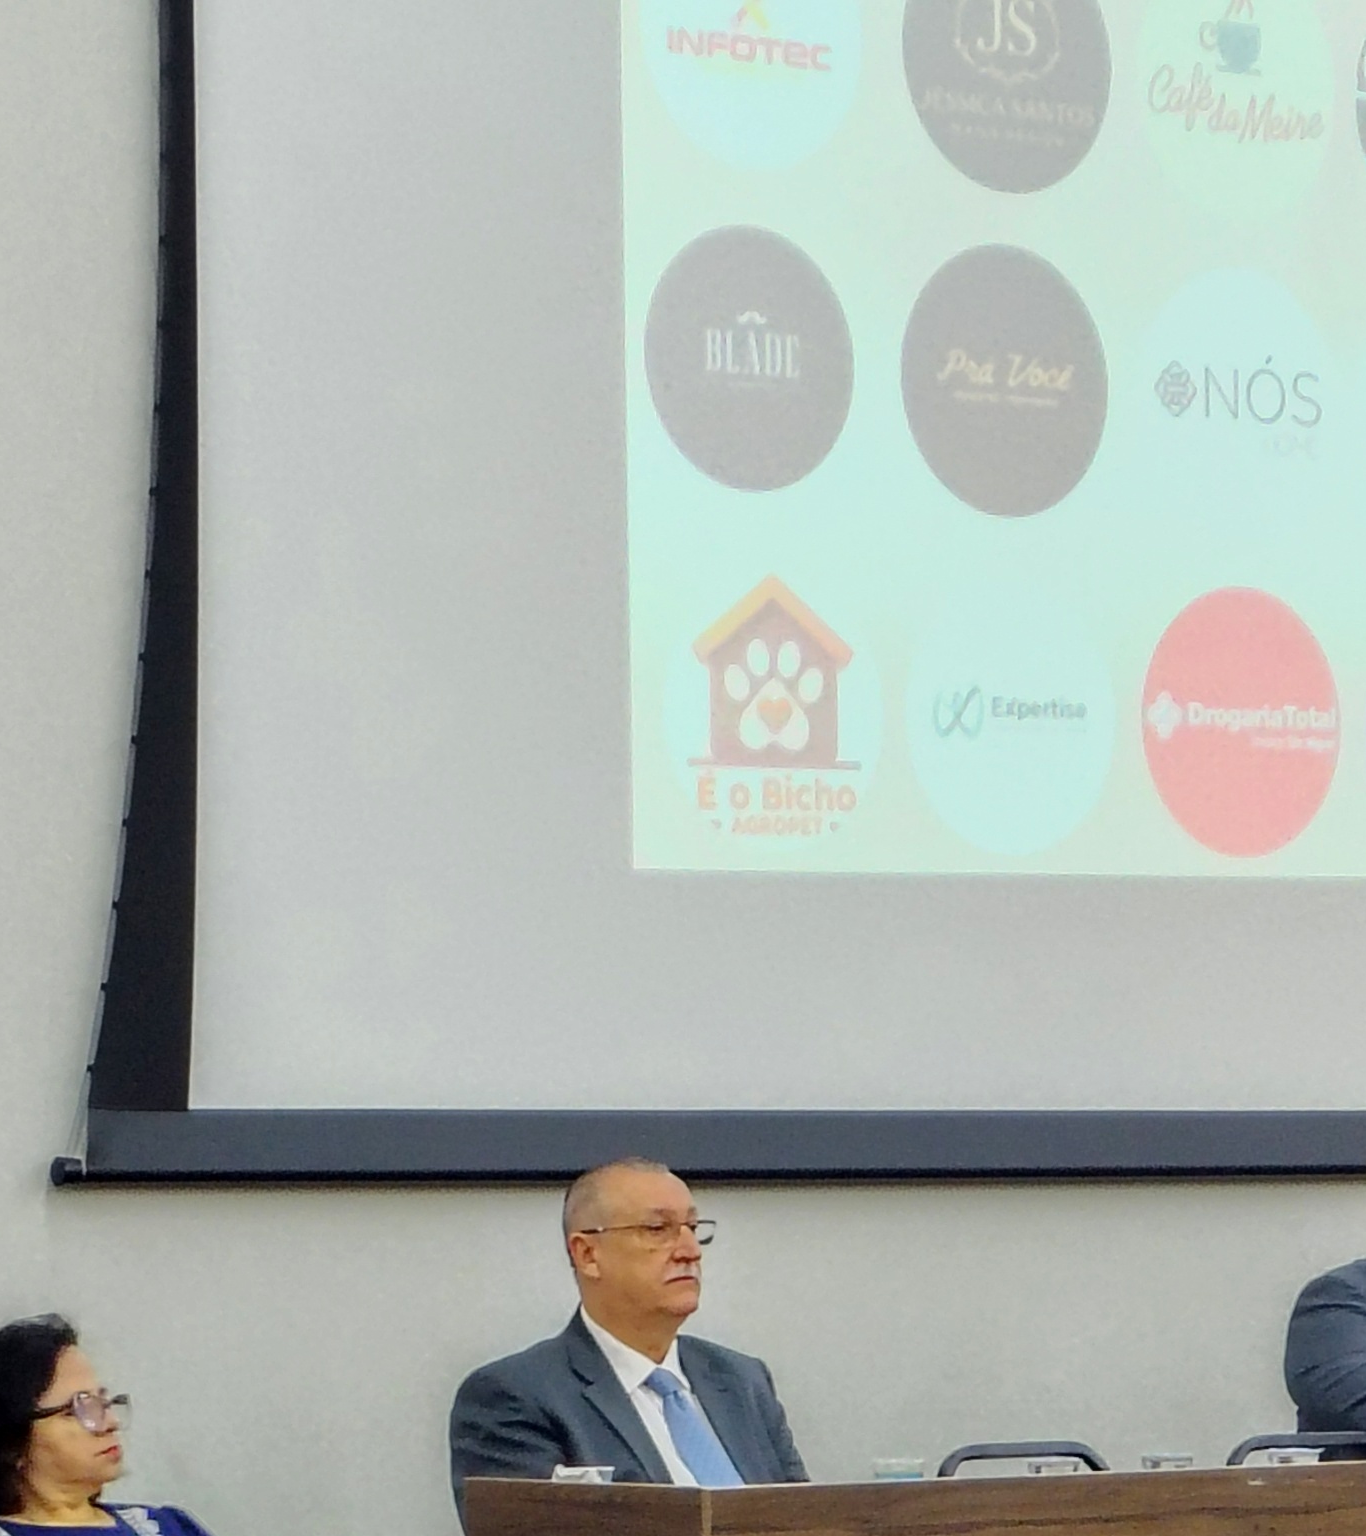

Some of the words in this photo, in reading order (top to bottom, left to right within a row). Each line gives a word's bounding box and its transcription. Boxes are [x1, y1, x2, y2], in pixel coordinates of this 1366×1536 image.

[1238, 93, 1325, 143] Meire
[705, 328, 800, 379] BLADE
[1204, 354, 1322, 428] NÓS
[991, 695, 1087, 720] Expertise
[730, 782, 750, 811] o
[762, 773, 857, 811] Bicho
